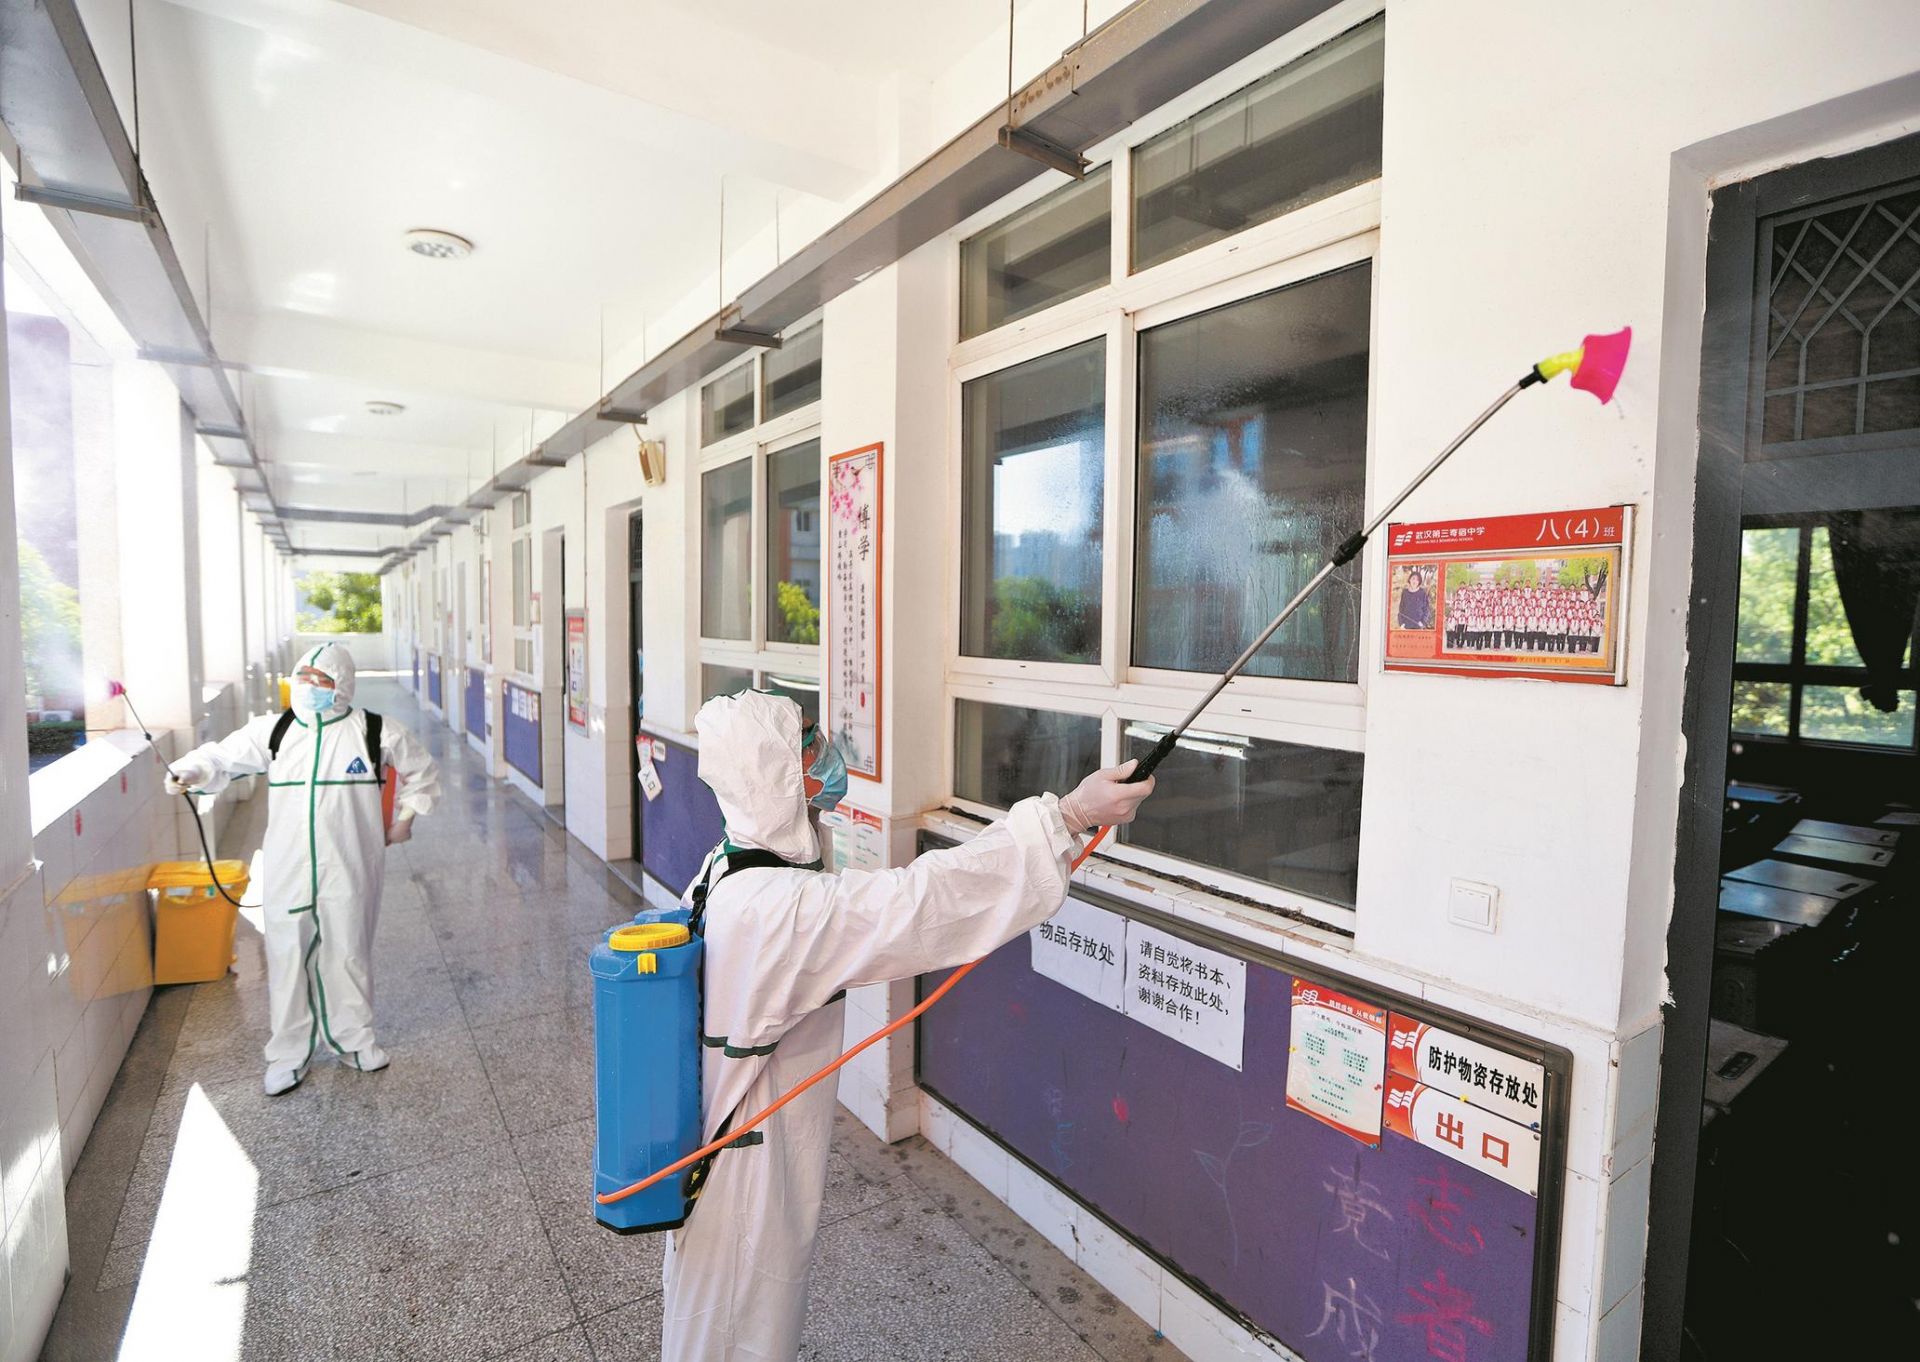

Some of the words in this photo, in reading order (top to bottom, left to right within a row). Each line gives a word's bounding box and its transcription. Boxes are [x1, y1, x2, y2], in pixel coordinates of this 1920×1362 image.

[858, 504, 870, 561] 博学
[1040, 921, 1115, 966] 物品存放处
[1139, 939, 1231, 989] 请自觉将书本、
[1138, 962, 1229, 1016] 资料存放此处，
[1138, 986, 1200, 1025] 谢谢合作！
[1429, 1045, 1538, 1109] 防护物资存放处
[1436, 1112, 1509, 1168] 出口
